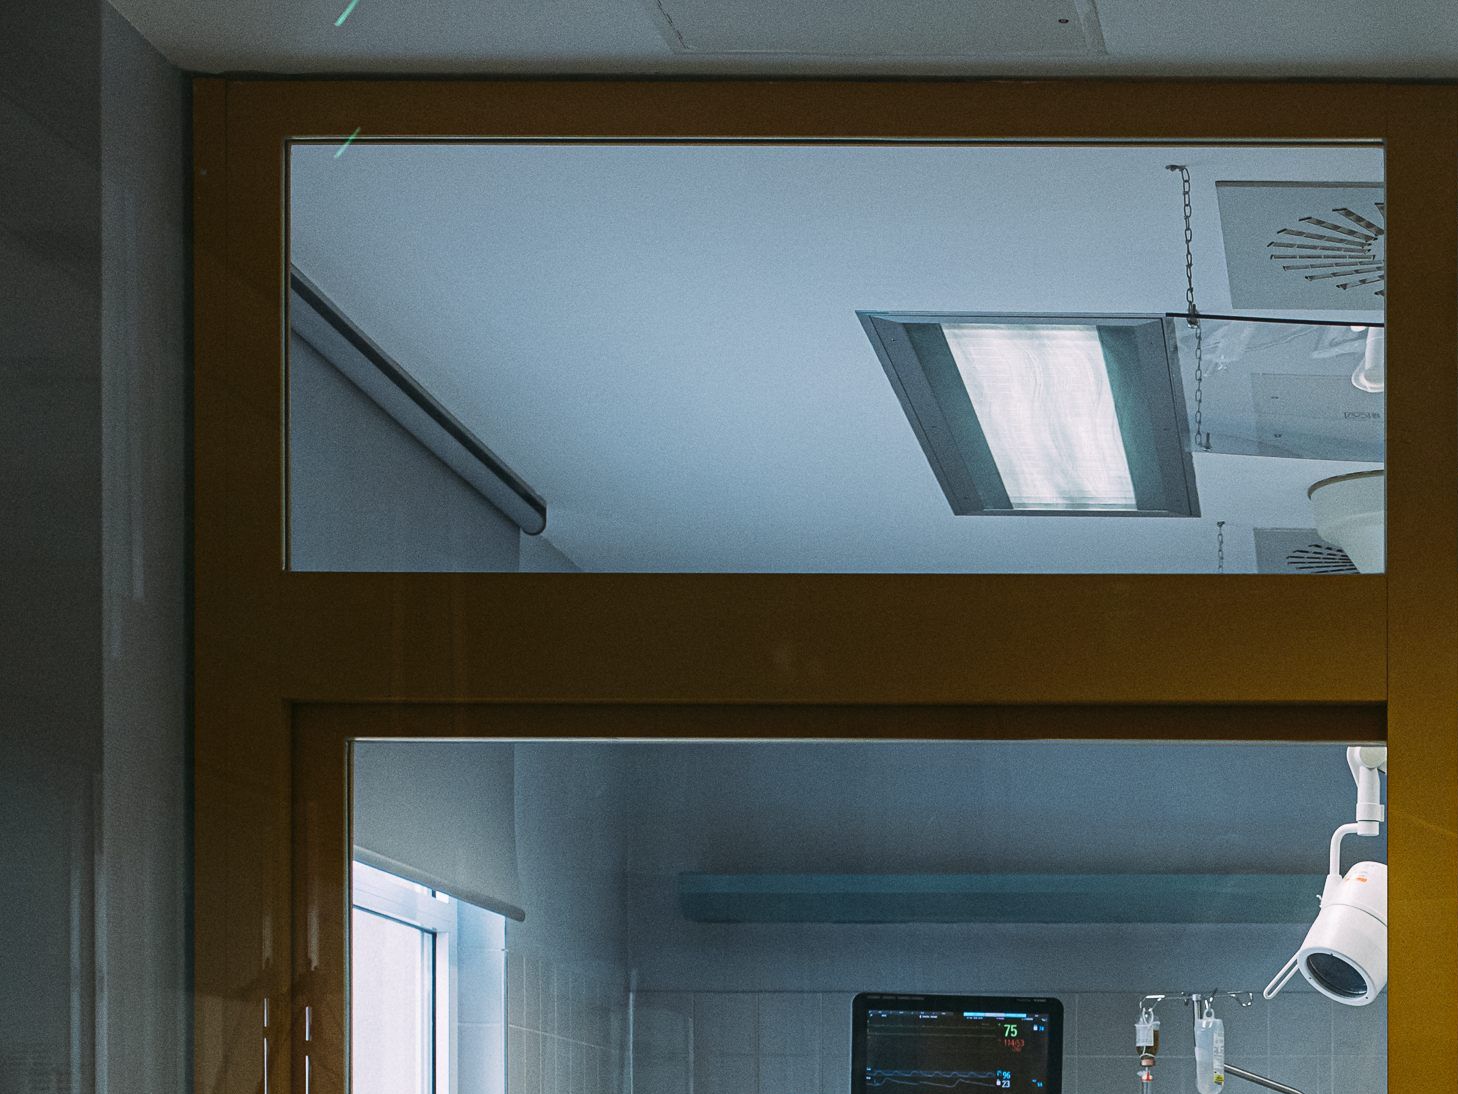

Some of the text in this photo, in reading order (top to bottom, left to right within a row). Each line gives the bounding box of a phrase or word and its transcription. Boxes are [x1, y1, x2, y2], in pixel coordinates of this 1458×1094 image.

[1003, 1024, 1018, 1037] 75
[1002, 1071, 1011, 1079] 96
[1001, 1080, 1010, 1088] 23
